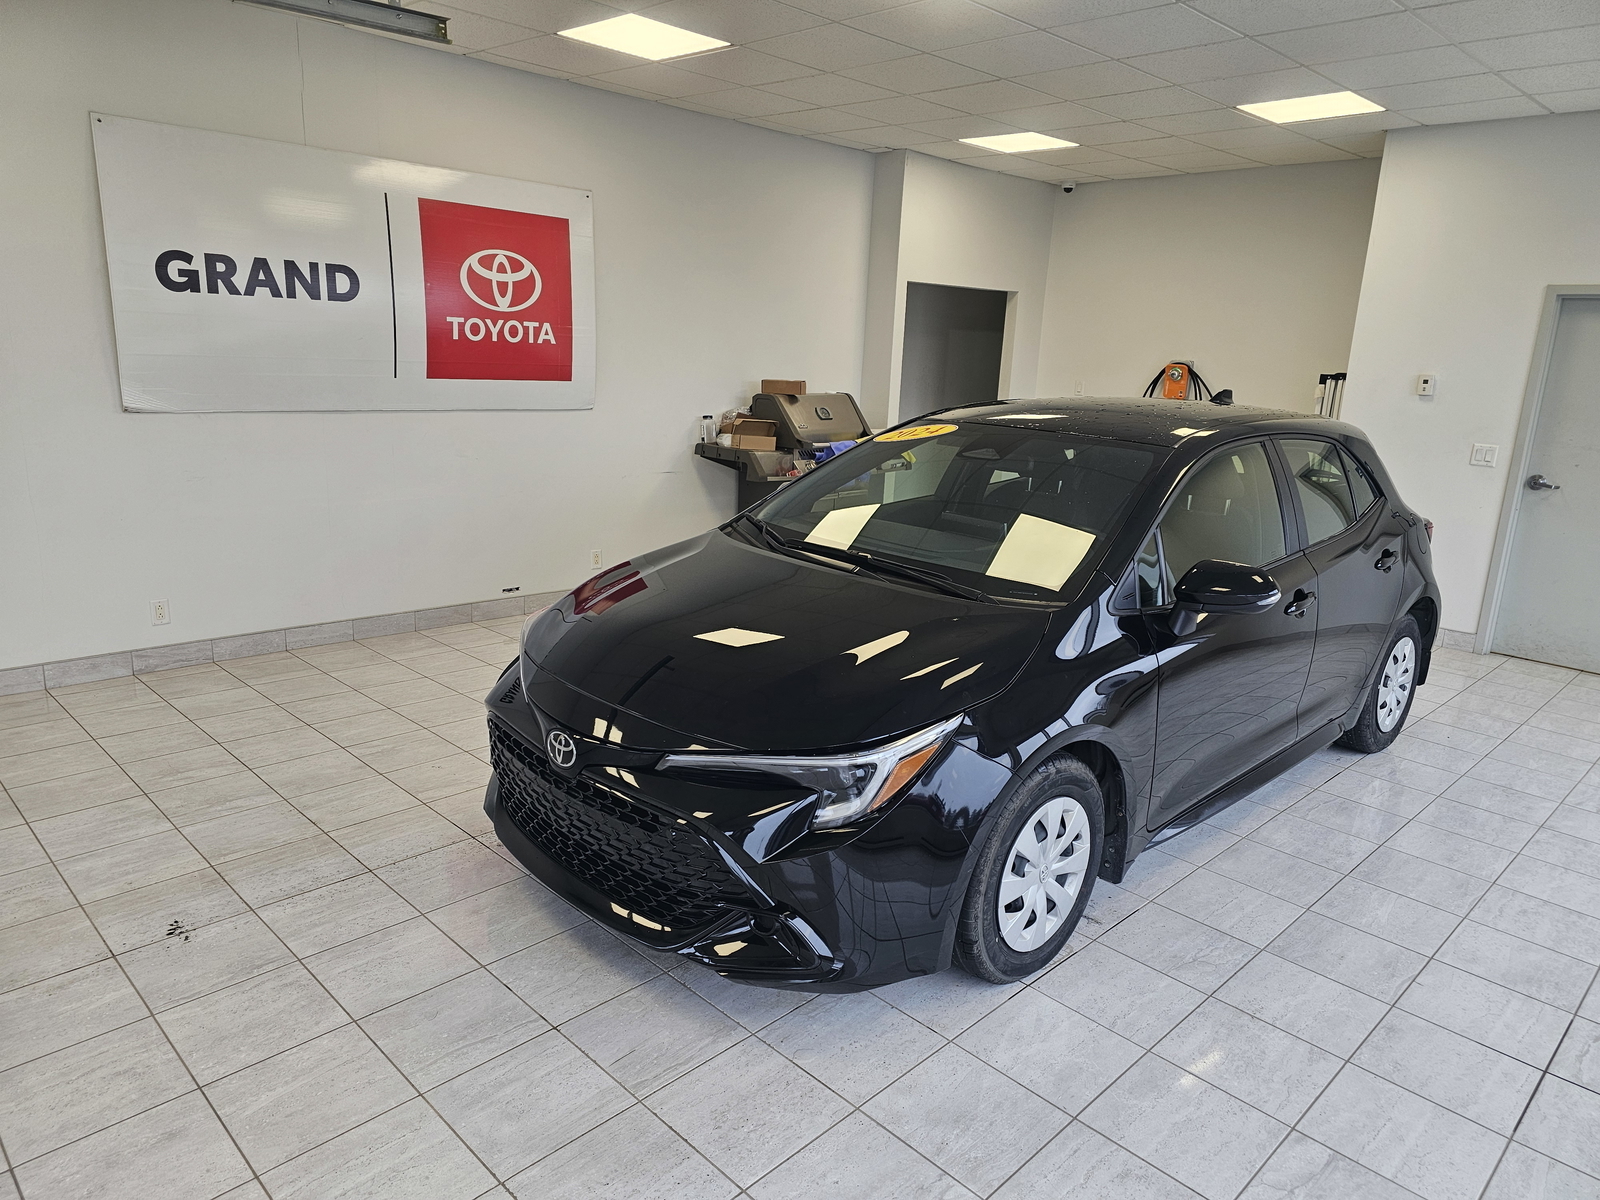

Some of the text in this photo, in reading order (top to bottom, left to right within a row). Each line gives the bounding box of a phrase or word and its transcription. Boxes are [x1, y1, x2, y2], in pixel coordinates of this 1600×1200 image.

[155, 249, 360, 302] GRAND
[446, 316, 556, 345] TOYOTA
[882, 425, 949, 440] 2024
